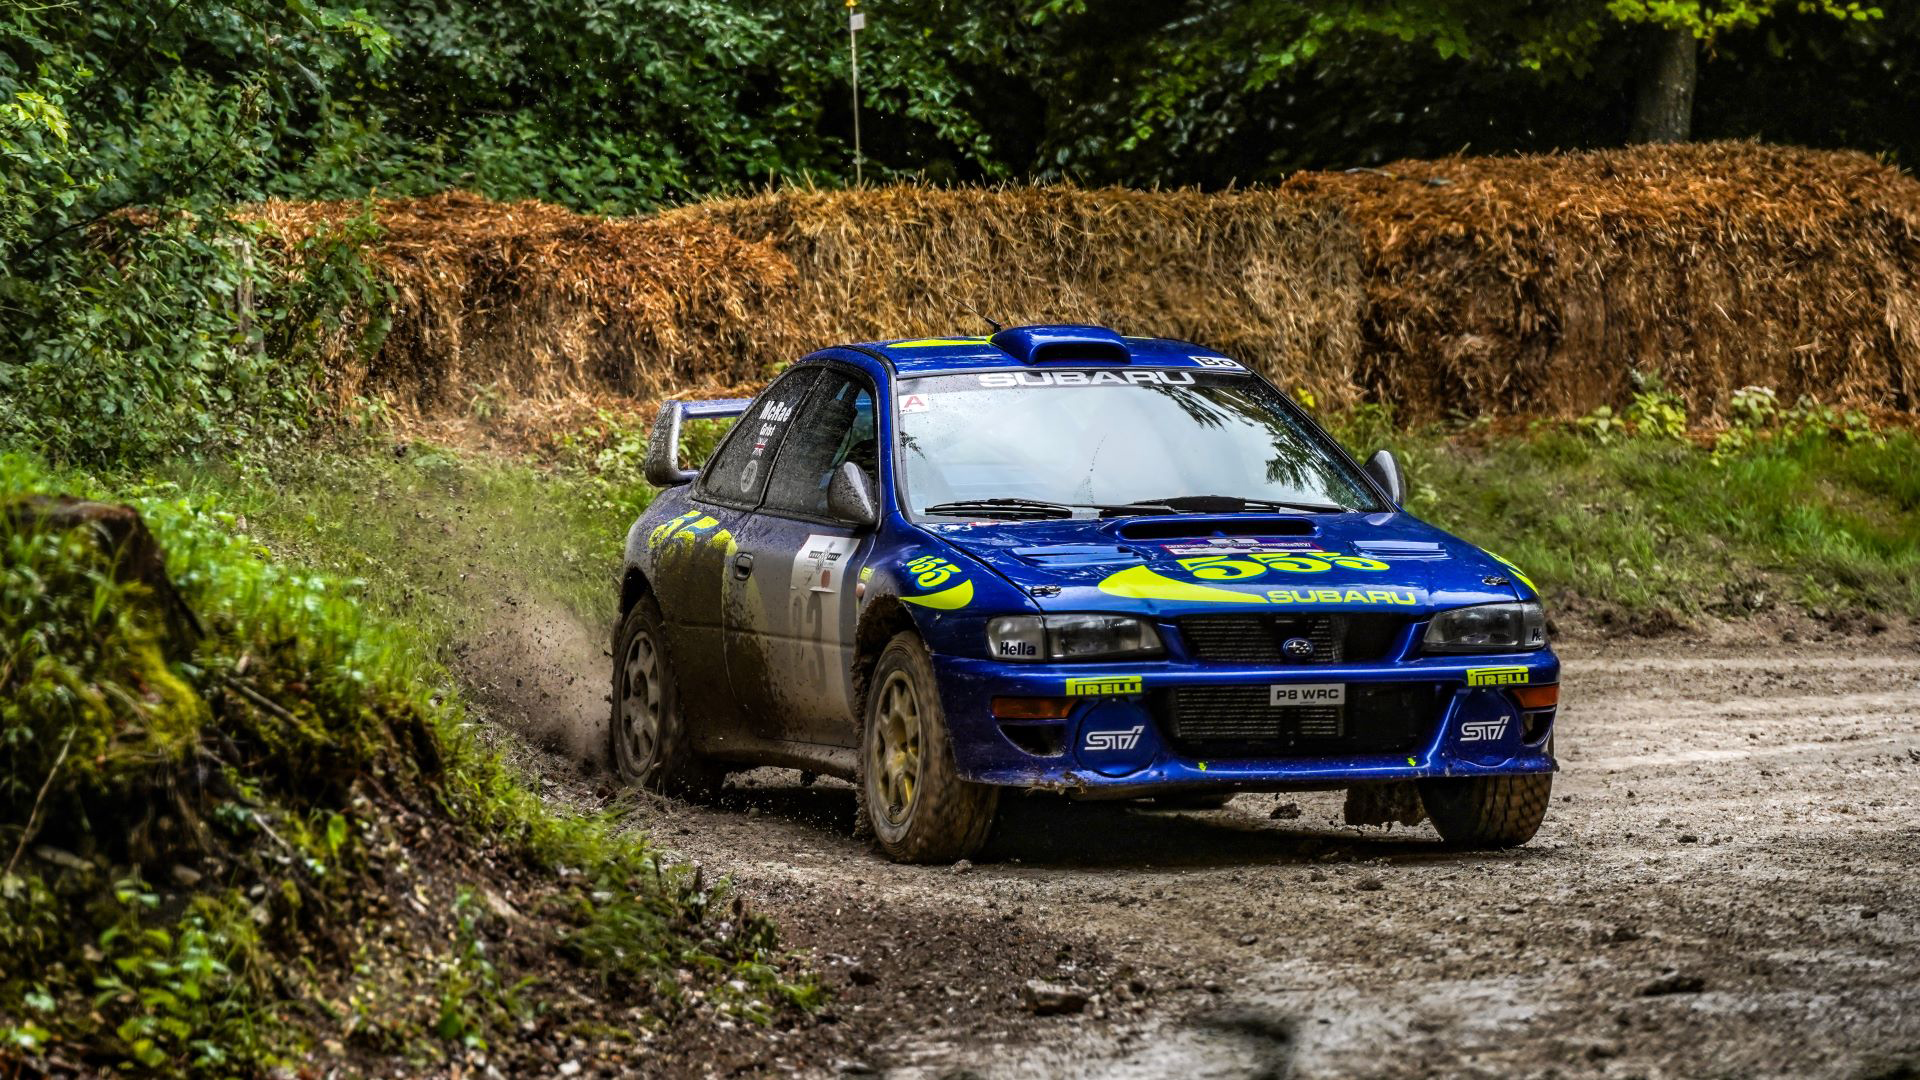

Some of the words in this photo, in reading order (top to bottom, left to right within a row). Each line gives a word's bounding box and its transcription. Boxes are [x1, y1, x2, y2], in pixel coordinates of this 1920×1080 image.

[978, 371, 1196, 388] SUBARU
[759, 400, 792, 422] McRae
[903, 394, 925, 409] A
[906, 555, 962, 587] 555
[1176, 552, 1391, 580] 555
[1266, 590, 1417, 605] SUBARU
[1000, 641, 1036, 656] Hella
[1466, 665, 1529, 687] PIRELLI
[1065, 675, 1143, 697] PIRELLI
[1276, 689, 1298, 701] P8
[1301, 688, 1339, 700] WRC
